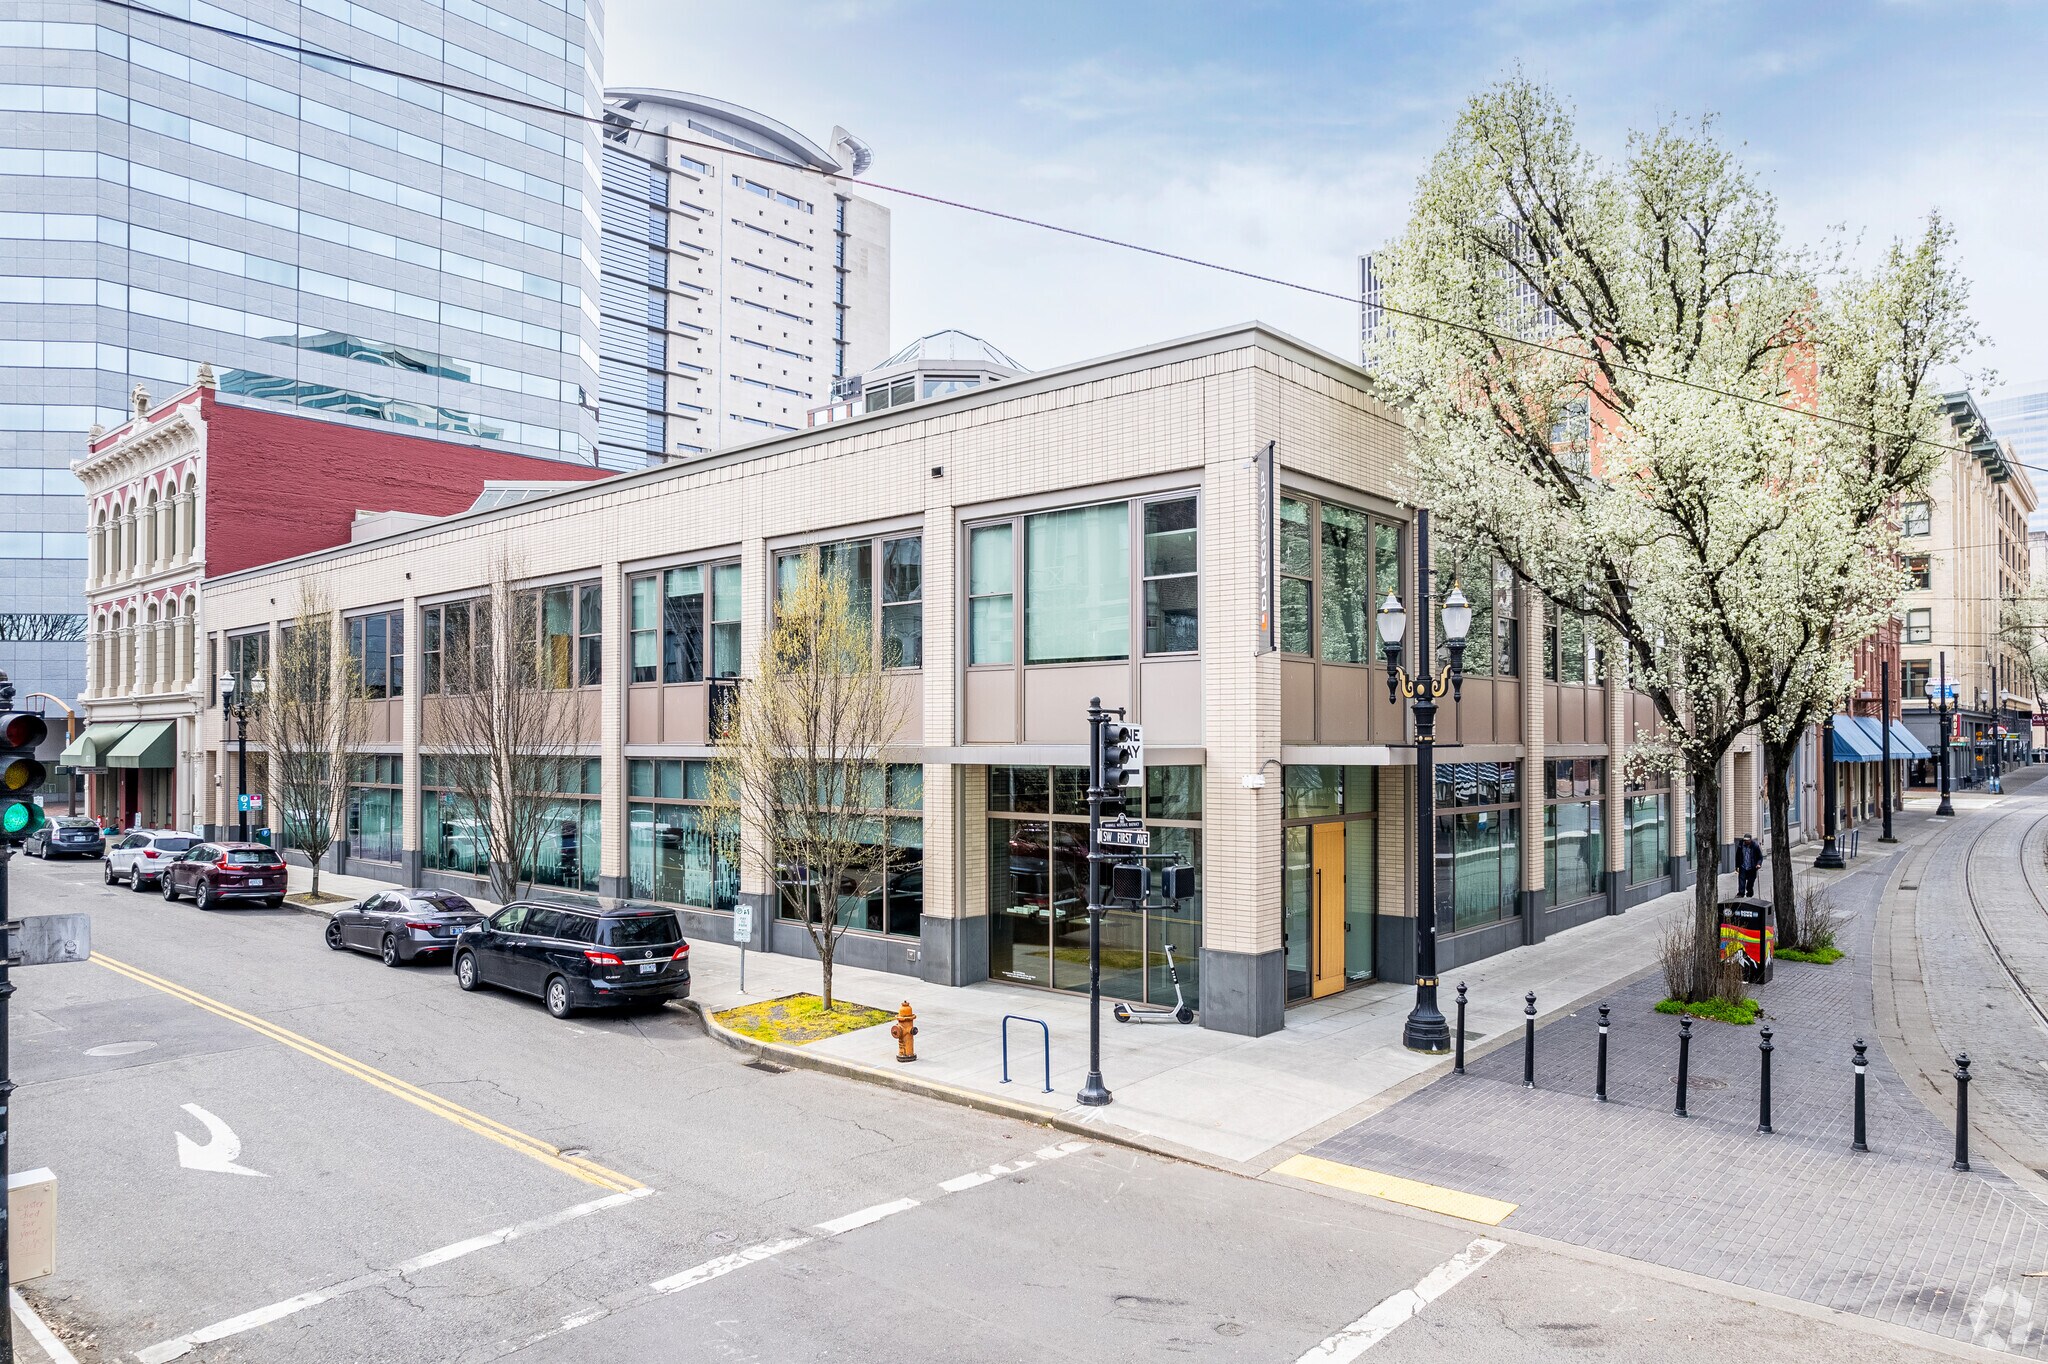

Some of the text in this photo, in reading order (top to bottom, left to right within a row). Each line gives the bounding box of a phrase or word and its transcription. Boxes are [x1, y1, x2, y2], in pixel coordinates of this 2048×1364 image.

[1103, 831, 1148, 845] SW FIRST AVE
